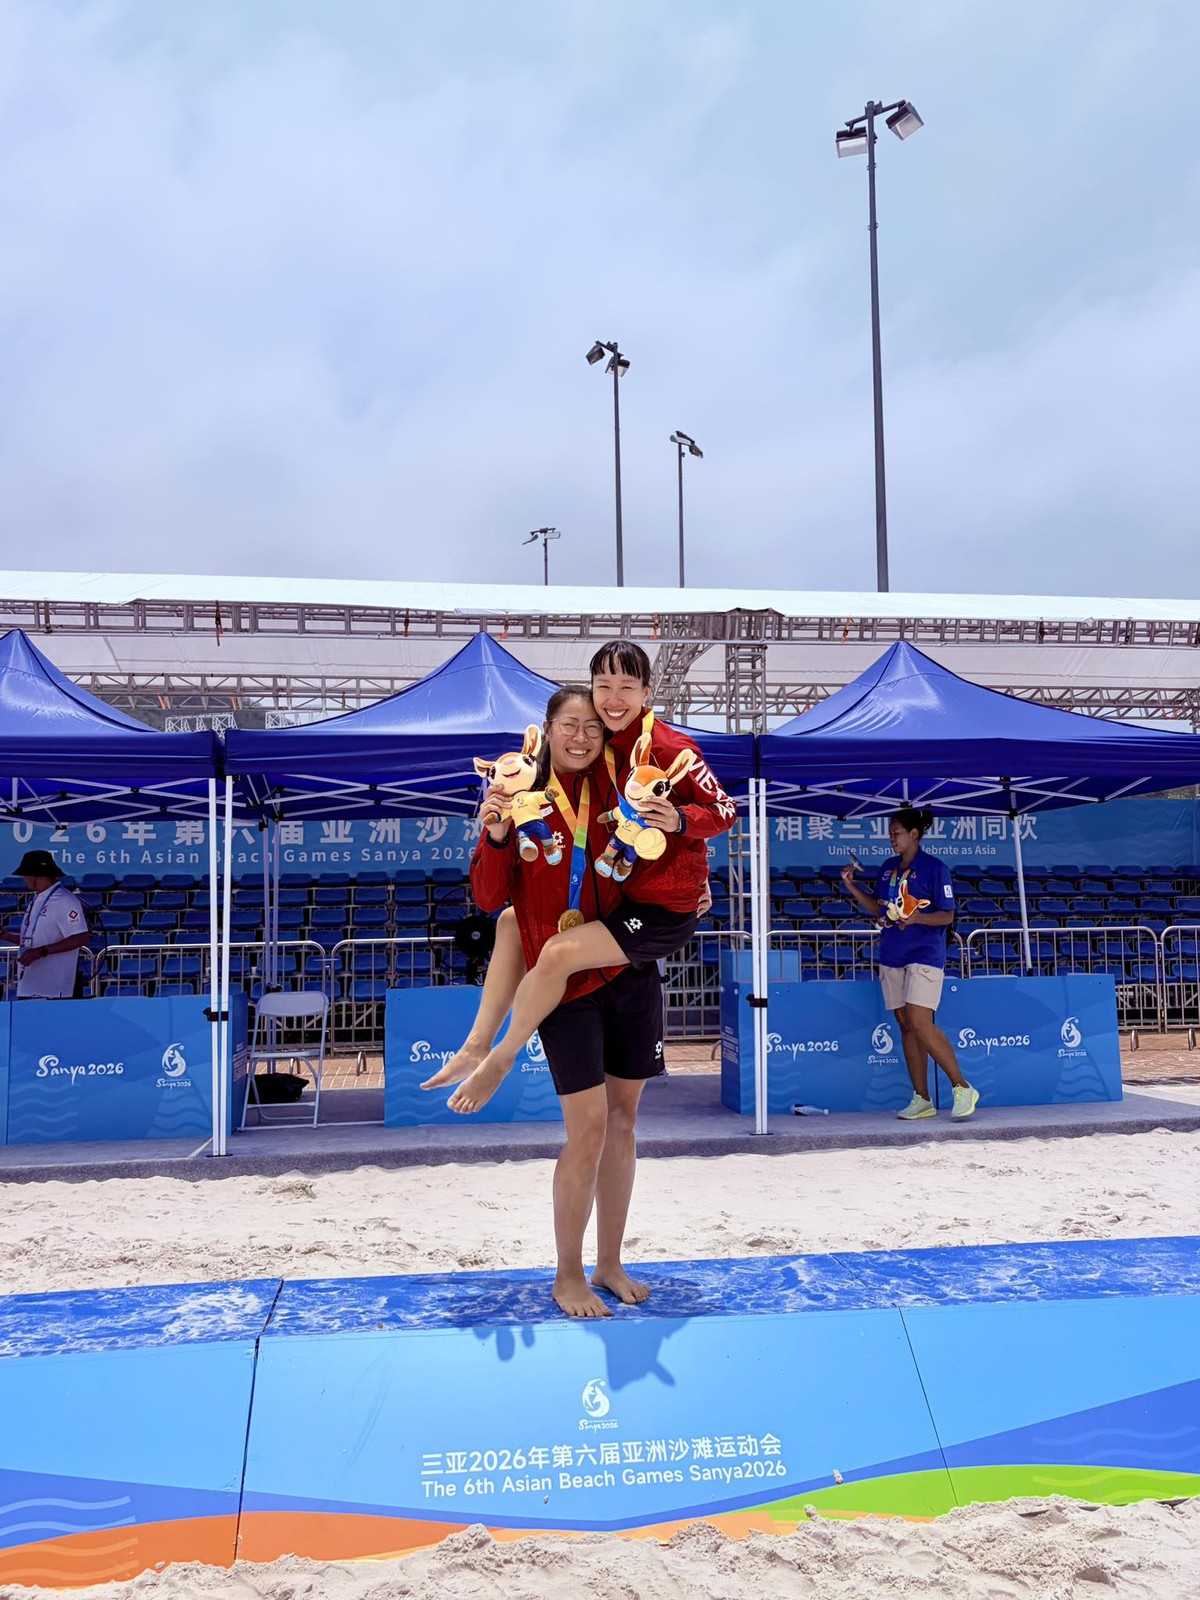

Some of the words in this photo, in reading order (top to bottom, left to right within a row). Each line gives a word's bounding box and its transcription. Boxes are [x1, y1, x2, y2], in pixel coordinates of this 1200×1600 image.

[51, 849, 86, 863] The
[96, 848, 131, 863] 6th
[140, 848, 200, 864] Asian
[283, 848, 351, 863] Games
[361, 847, 421, 864] Sanya
[431, 846, 477, 860] 2026
[828, 845, 857, 855] Unite
[859, 845, 869, 855] in
[961, 847, 973, 855] as
[974, 845, 996, 855] Asia
[420, 1432, 782, 1476] 三亚2026年第六届亚洲沙滩运动会
[421, 1479, 457, 1498] The
[463, 1476, 495, 1496] 6th
[501, 1473, 553, 1494] Asian
[559, 1468, 616, 1490] Beach
[621, 1464, 684, 1486] Games
[689, 1460, 788, 1485] Sanya2026
